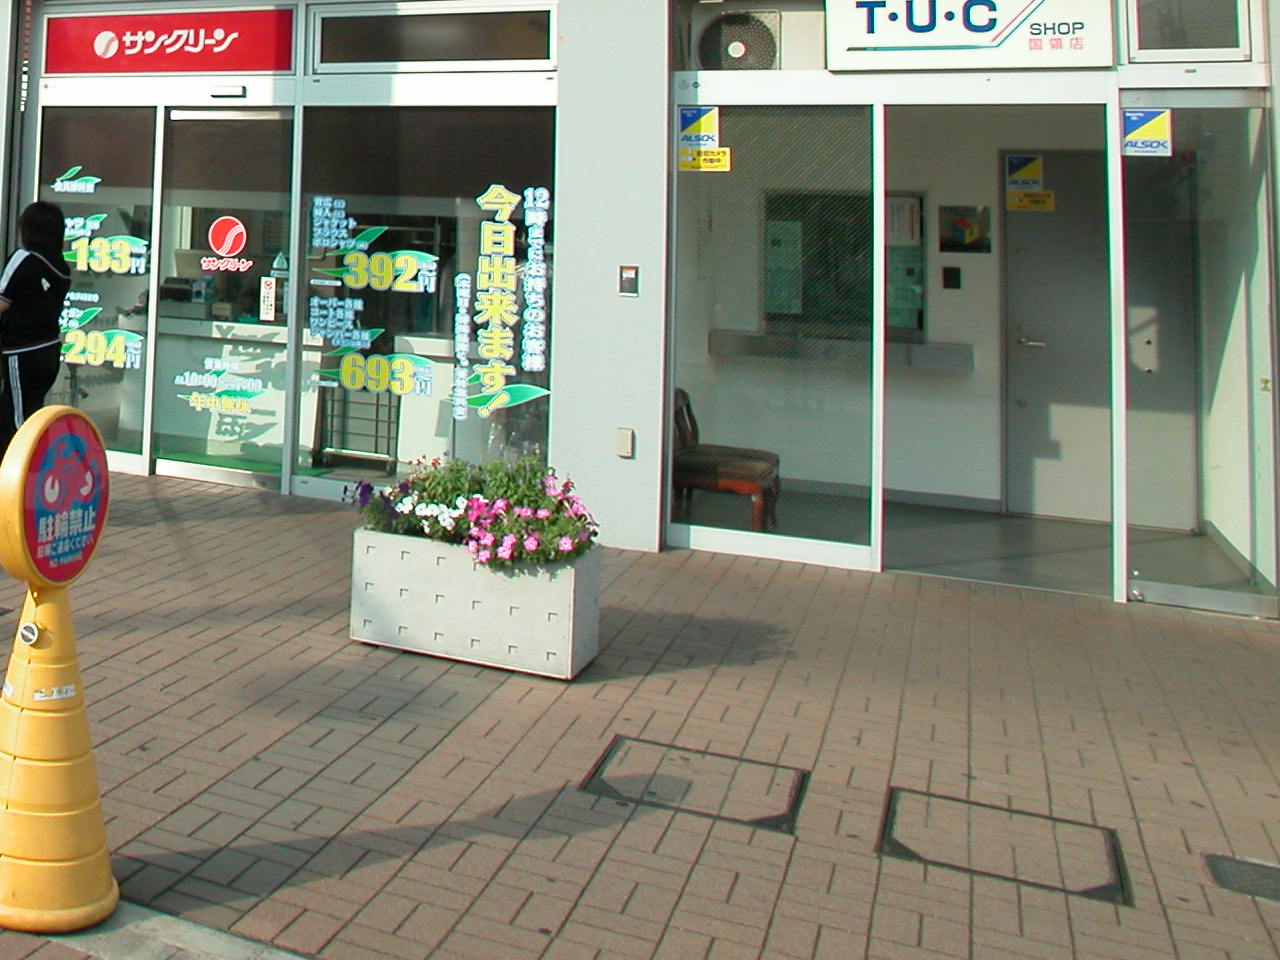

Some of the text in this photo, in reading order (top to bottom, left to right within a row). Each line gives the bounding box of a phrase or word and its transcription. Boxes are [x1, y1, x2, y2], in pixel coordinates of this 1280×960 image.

[1029, 21, 1085, 36] SHOP
[122, 27, 239, 56] サンクリーン
[1029, 37, 1084, 50] 国領店
[1124, 140, 1169, 149] ALSOK
[38, 505, 97, 544] 駐輪禁止
